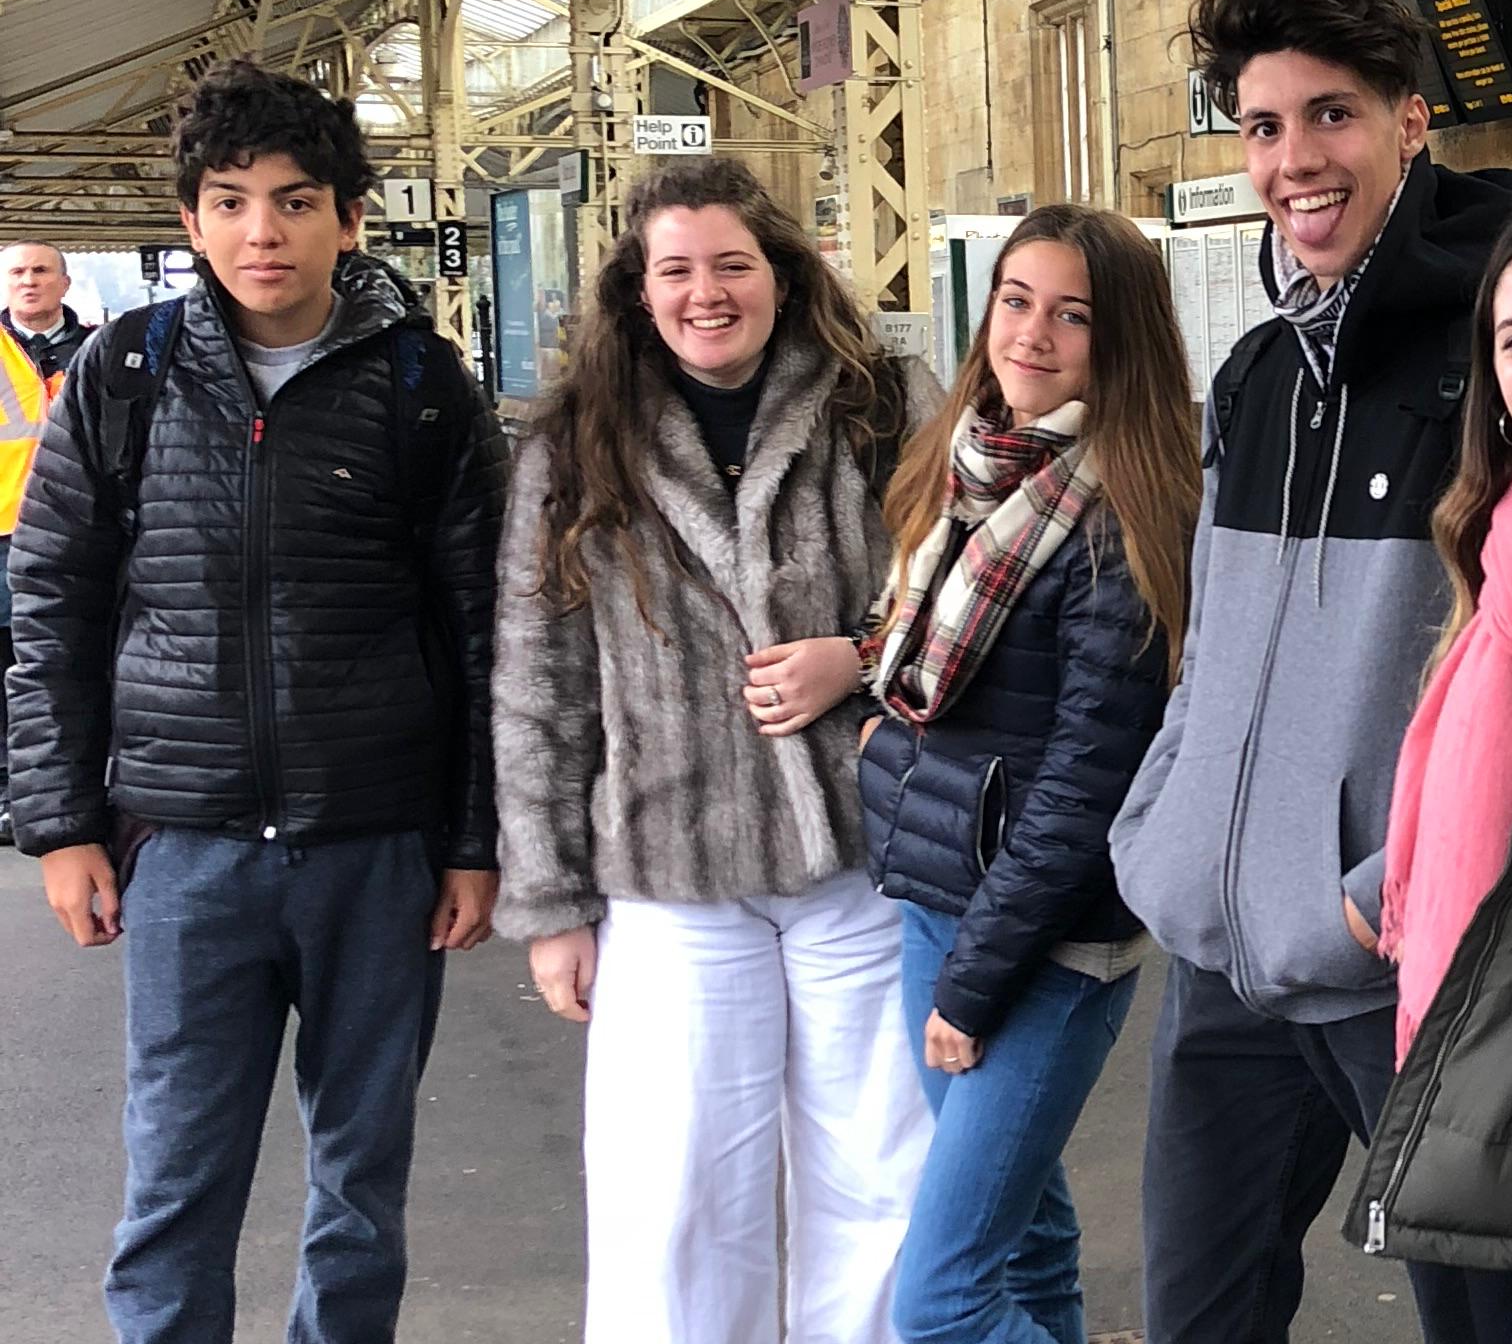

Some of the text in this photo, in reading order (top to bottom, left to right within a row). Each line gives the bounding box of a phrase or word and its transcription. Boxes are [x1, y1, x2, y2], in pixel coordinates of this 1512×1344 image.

[636, 119, 673, 136] Help
[637, 137, 678, 150] Point
[401, 185, 414, 215] 1
[1189, 183, 1235, 210] Information
[444, 226, 460, 245] 2
[444, 248, 461, 268] 3
